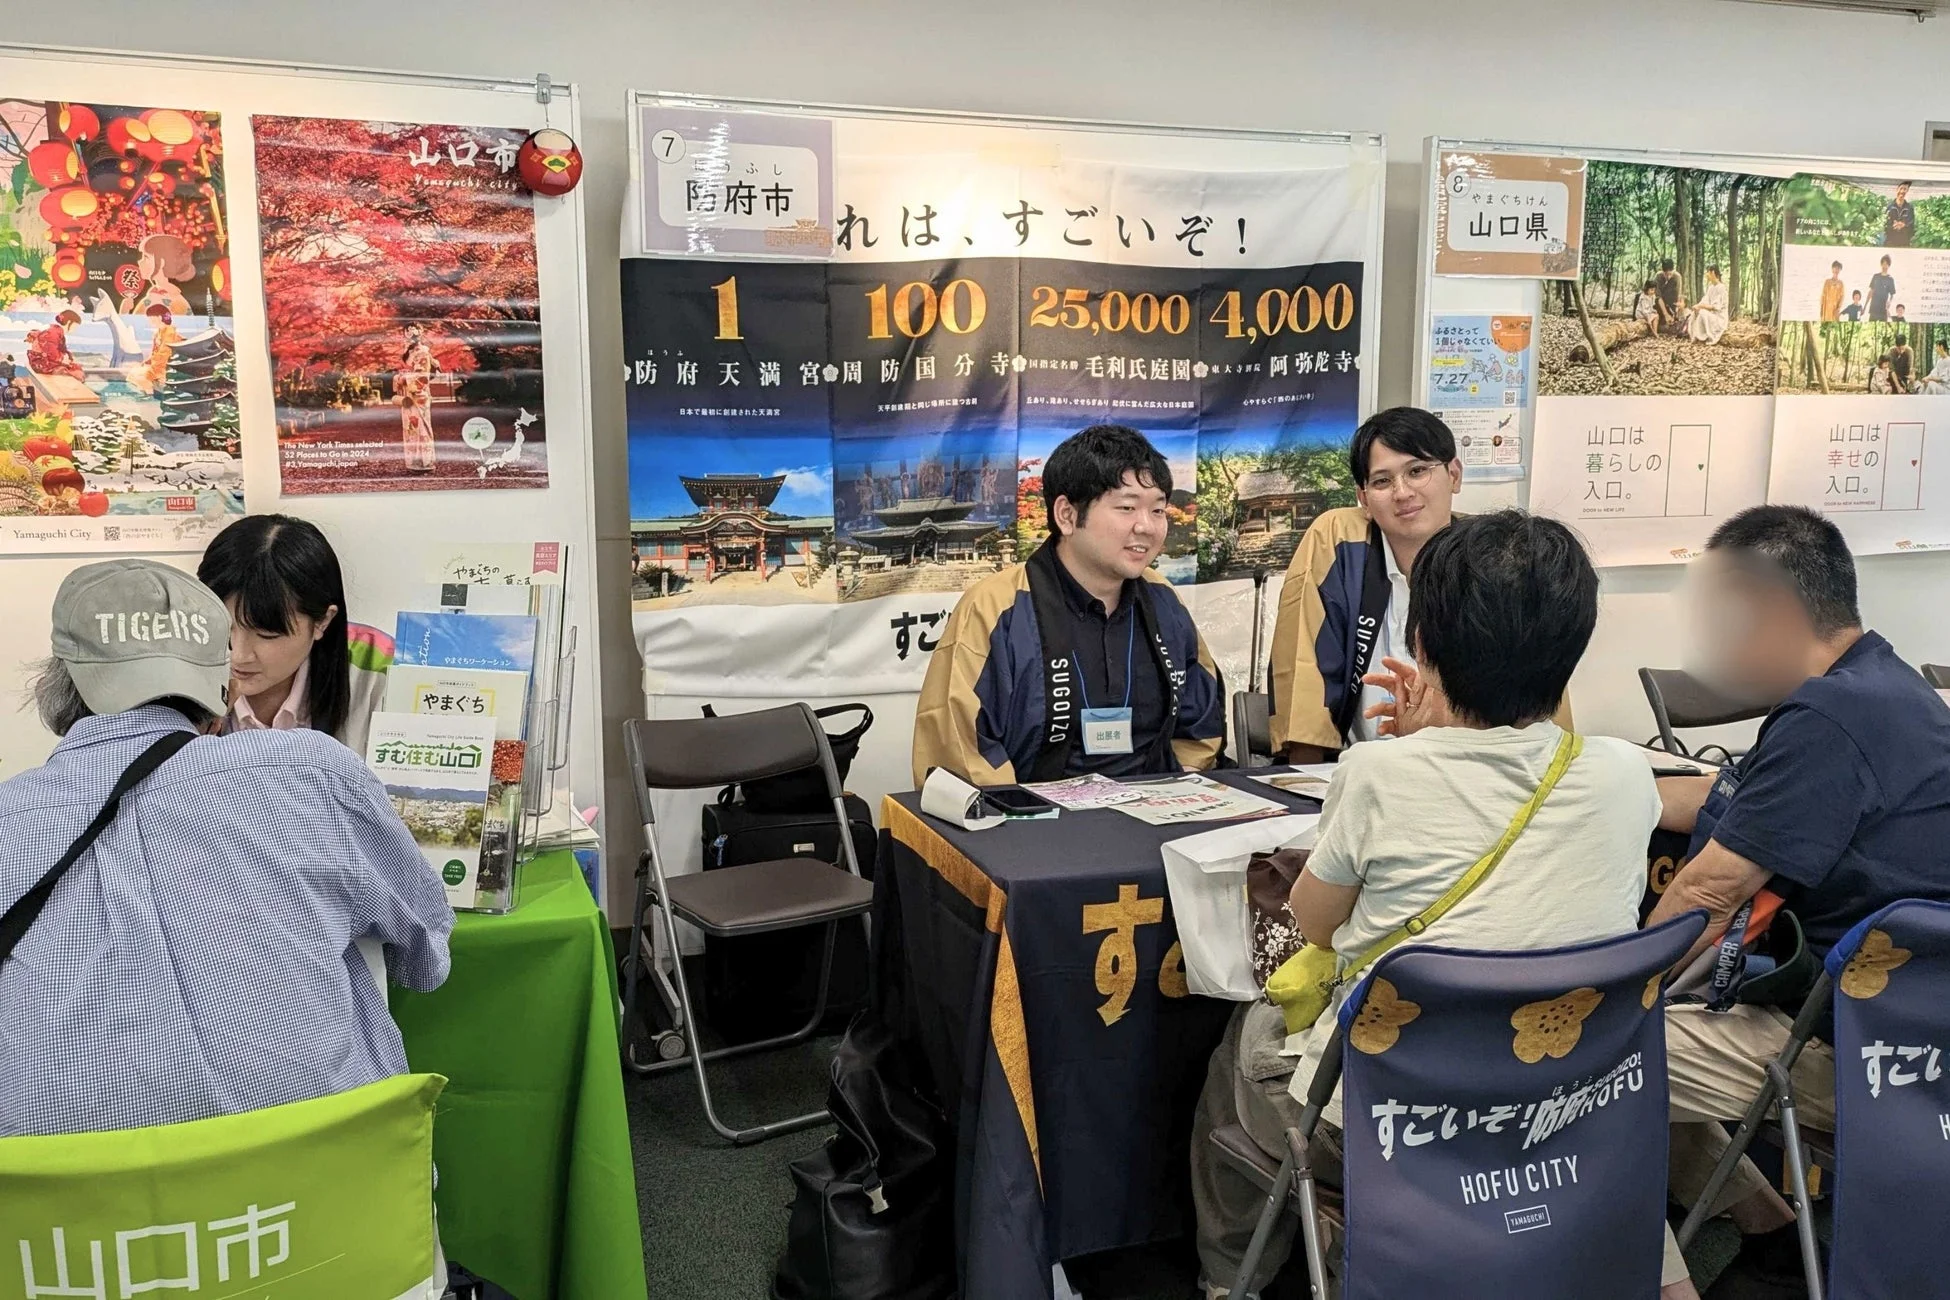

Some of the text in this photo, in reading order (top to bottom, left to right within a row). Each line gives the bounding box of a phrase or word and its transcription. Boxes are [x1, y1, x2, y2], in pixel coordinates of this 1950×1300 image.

[408, 135, 520, 174] 山口市
[662, 137, 675, 157] 7
[414, 173, 480, 188] Yamaguchi
[1453, 175, 1463, 193] 8
[686, 180, 793, 217] 防府市
[1472, 194, 1548, 207] やまぐちけん
[1470, 211, 1549, 242] 山口県
[123, 270, 140, 288] 祭
[711, 276, 744, 340] 1
[865, 279, 987, 339] 100
[1030, 286, 1190, 336] 25,000
[1209, 283, 1354, 344] 4,000
[635, 360, 821, 387] 防府天満宮
[842, 352, 1009, 384] 周防国分寺
[1029, 356, 1191, 381] 国指定名勝 毛利氏庭園
[1270, 351, 1352, 378] 阿弥陀寺
[1434, 373, 1468, 385] 7.27
[1588, 425, 1645, 446] 山口は
[1830, 424, 1881, 442] 山口は
[284, 441, 296, 449] The
[317, 441, 333, 449] York
[334, 441, 354, 449] Times
[355, 441, 384, 449] selected
[285, 451, 295, 459] 52
[296, 451, 319, 459] Places
[349, 450, 370, 458] 2024
[1586, 453, 1662, 473] 暮らしの
[1828, 449, 1879, 468] 幸せの
[1583, 481, 1632, 500] 入口。
[1825, 475, 1868, 494] 入口。
[13, 529, 92, 540] Yamaguchi City
[453, 563, 500, 580] やまぐちの
[95, 610, 209, 645] TIGERS
[890, 609, 952, 661] すご
[423, 694, 485, 713] やまぐち
[1049, 658, 1071, 743] SUGOIZO
[1096, 730, 1121, 741] 出展者
[375, 749, 476, 769] すむ住む山口
[484, 819, 504, 829] まぐち
[1715, 941, 1739, 988] CAMPER
[1579, 1068, 1644, 1117] HOFU
[1460, 1155, 1579, 1206] HOFU CITY
[1510, 1212, 1546, 1228] YAMAGUCHI
[19, 1201, 296, 1300] 山口市
